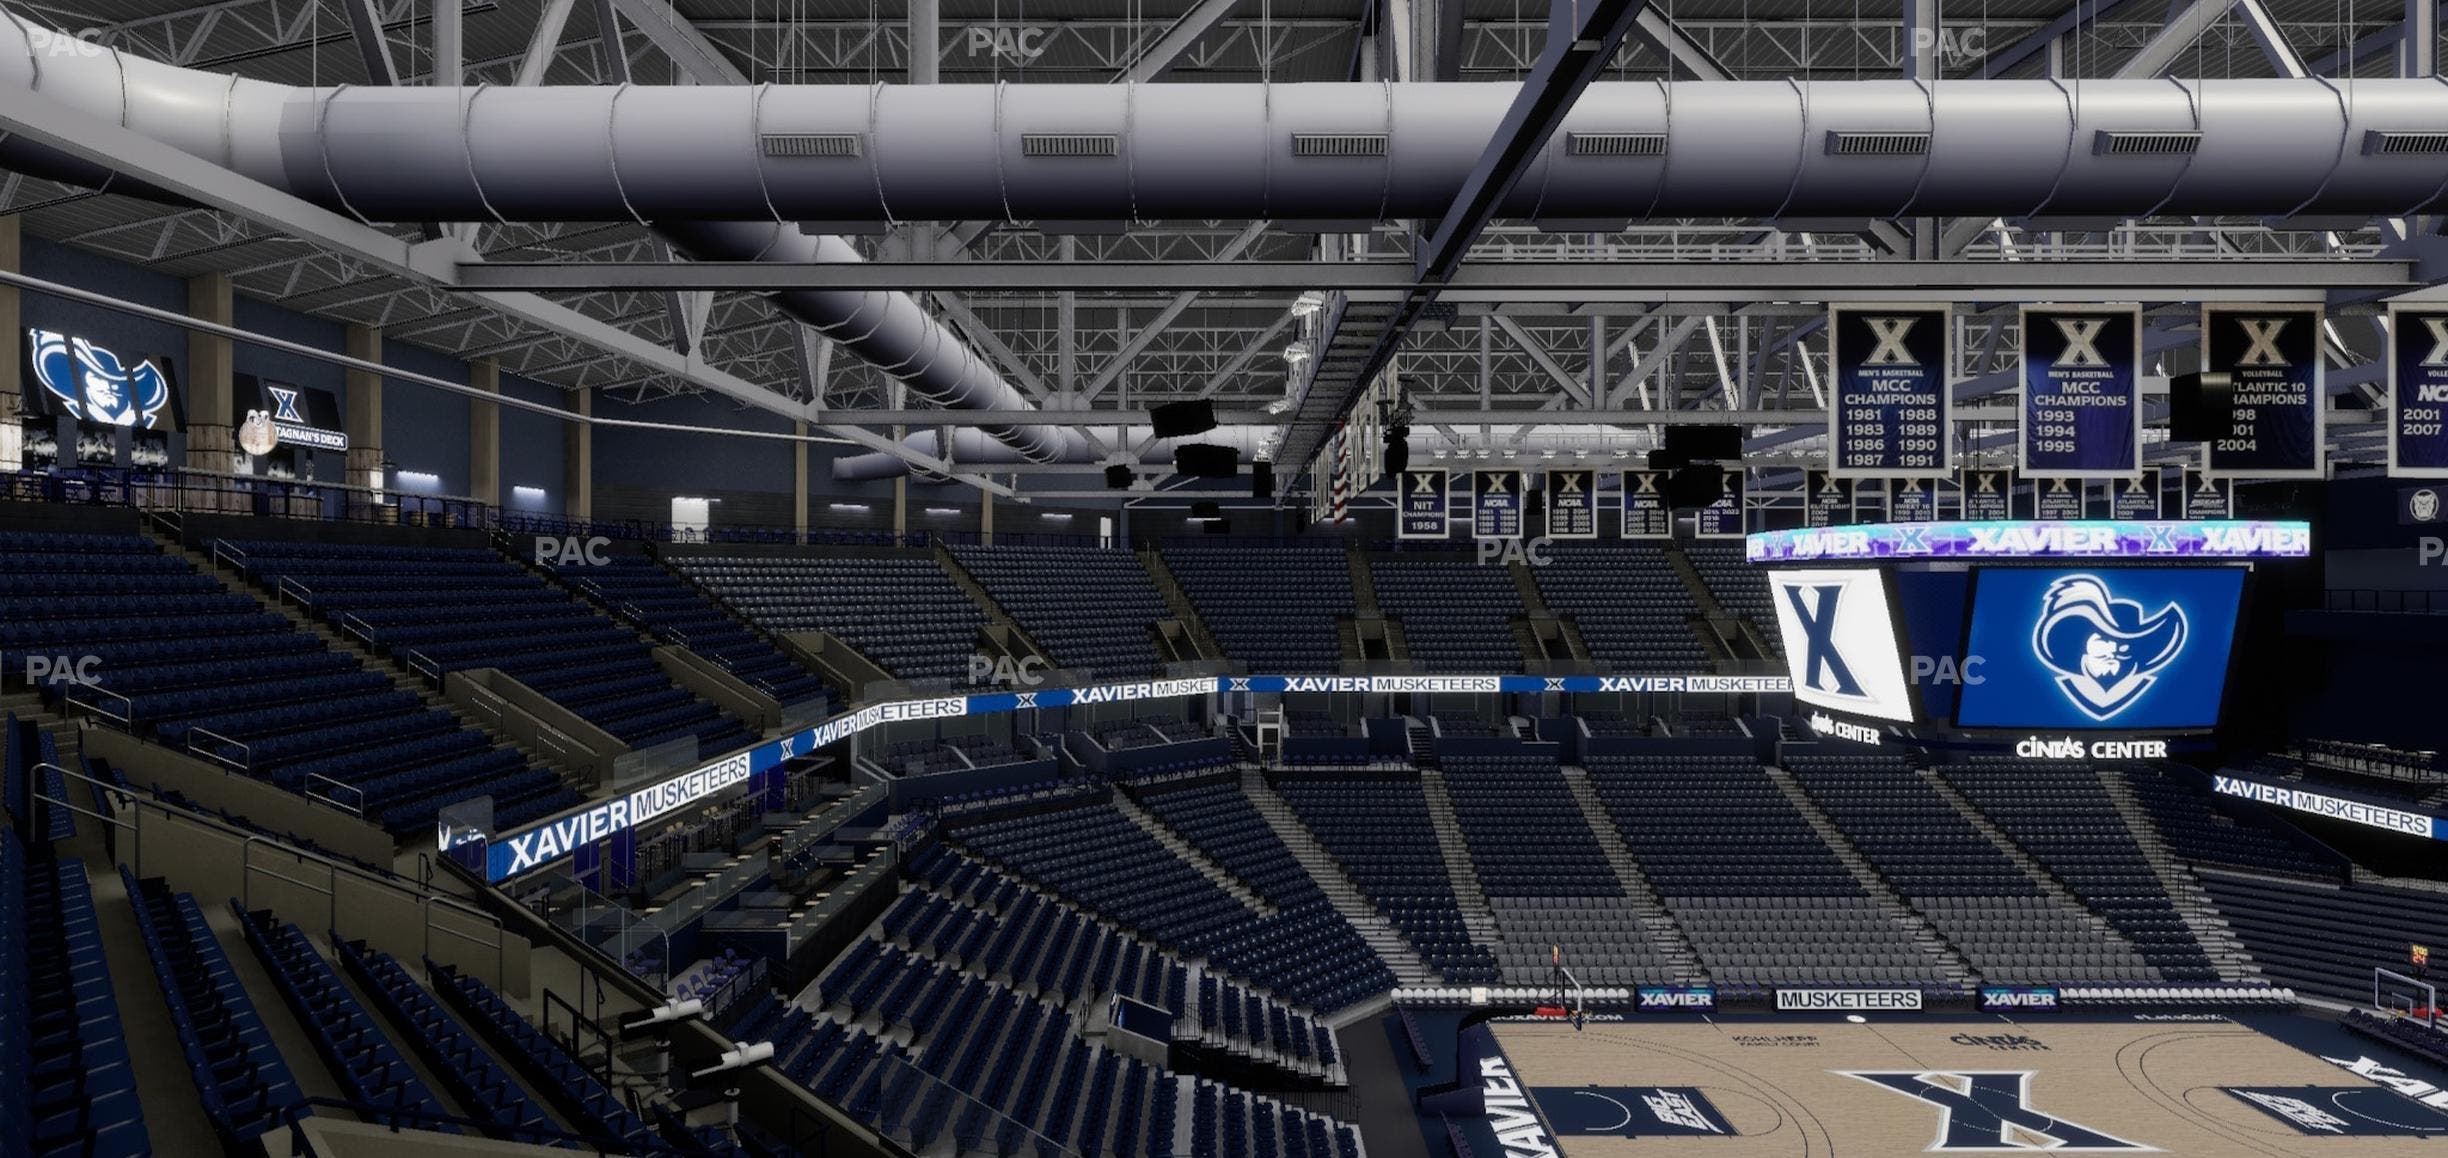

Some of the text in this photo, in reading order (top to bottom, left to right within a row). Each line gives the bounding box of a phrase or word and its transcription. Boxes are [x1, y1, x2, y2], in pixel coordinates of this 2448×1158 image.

[1861, 317, 1921, 366] X
[2051, 318, 2111, 367] X
[2234, 318, 2292, 367] X
[1872, 379, 1911, 391] MCC
[2062, 381, 2101, 393] MCC
[2291, 382, 2306, 392] 10
[267, 386, 304, 423] X
[1845, 394, 1936, 405] CHAMPIONS
[2035, 395, 2127, 406] CHAMPIONS
[1847, 409, 1937, 420] 1981 1988
[2036, 411, 2075, 422] 1993
[2403, 409, 2440, 420] 2001
[1847, 424, 1937, 436] 1983 1989
[2036, 426, 2075, 436] 1994
[2403, 424, 2442, 435] 2007
[320, 434, 344, 447] DECK
[1847, 439, 1937, 450] 1986 1990
[2036, 440, 2075, 452] 1995
[2217, 439, 2256, 451] 2004
[1847, 454, 1934, 466] 1987 1991
[1413, 473, 1434, 493] X
[1486, 473, 1509, 493] X
[1559, 473, 1583, 493] X
[1635, 473, 1659, 493] X
[1413, 501, 1434, 510] NIT
[1484, 499, 1509, 508] NCAA
[1557, 499, 1584, 508] NCAA
[1633, 500, 1660, 508] NCAA
[1412, 521, 1438, 530] 1958
[1791, 532, 1871, 555] XAVIER
[1896, 527, 1934, 554] X
[1966, 527, 2118, 552] XAVIER
[2146, 526, 2177, 552] X
[1776, 578, 1877, 704] X
[1284, 677, 1370, 692] XAVIER
[1376, 679, 1496, 691] MUSKETEERS
[1600, 677, 1685, 692] XAVIER
[1071, 683, 1150, 704] XAVIER
[1835, 721, 1880, 745] CENTER
[2091, 740, 2168, 759] CENTER
[507, 799, 629, 876] XAVIER
[636, 755, 747, 819] MUSKETEERS
[780, 738, 794, 761] X
[812, 715, 857, 750] XAVIER
[858, 698, 962, 732] MUSKETEERS
[1015, 693, 1038, 708] X
[2214, 775, 2428, 834] XAVIER MUSKETEERS
[1640, 992, 1712, 1006] XAVIER
[1781, 990, 1918, 1008] MUSKETEERS
[1984, 993, 2056, 1007] XAVIER
[1825, 1069, 2171, 1152] X
